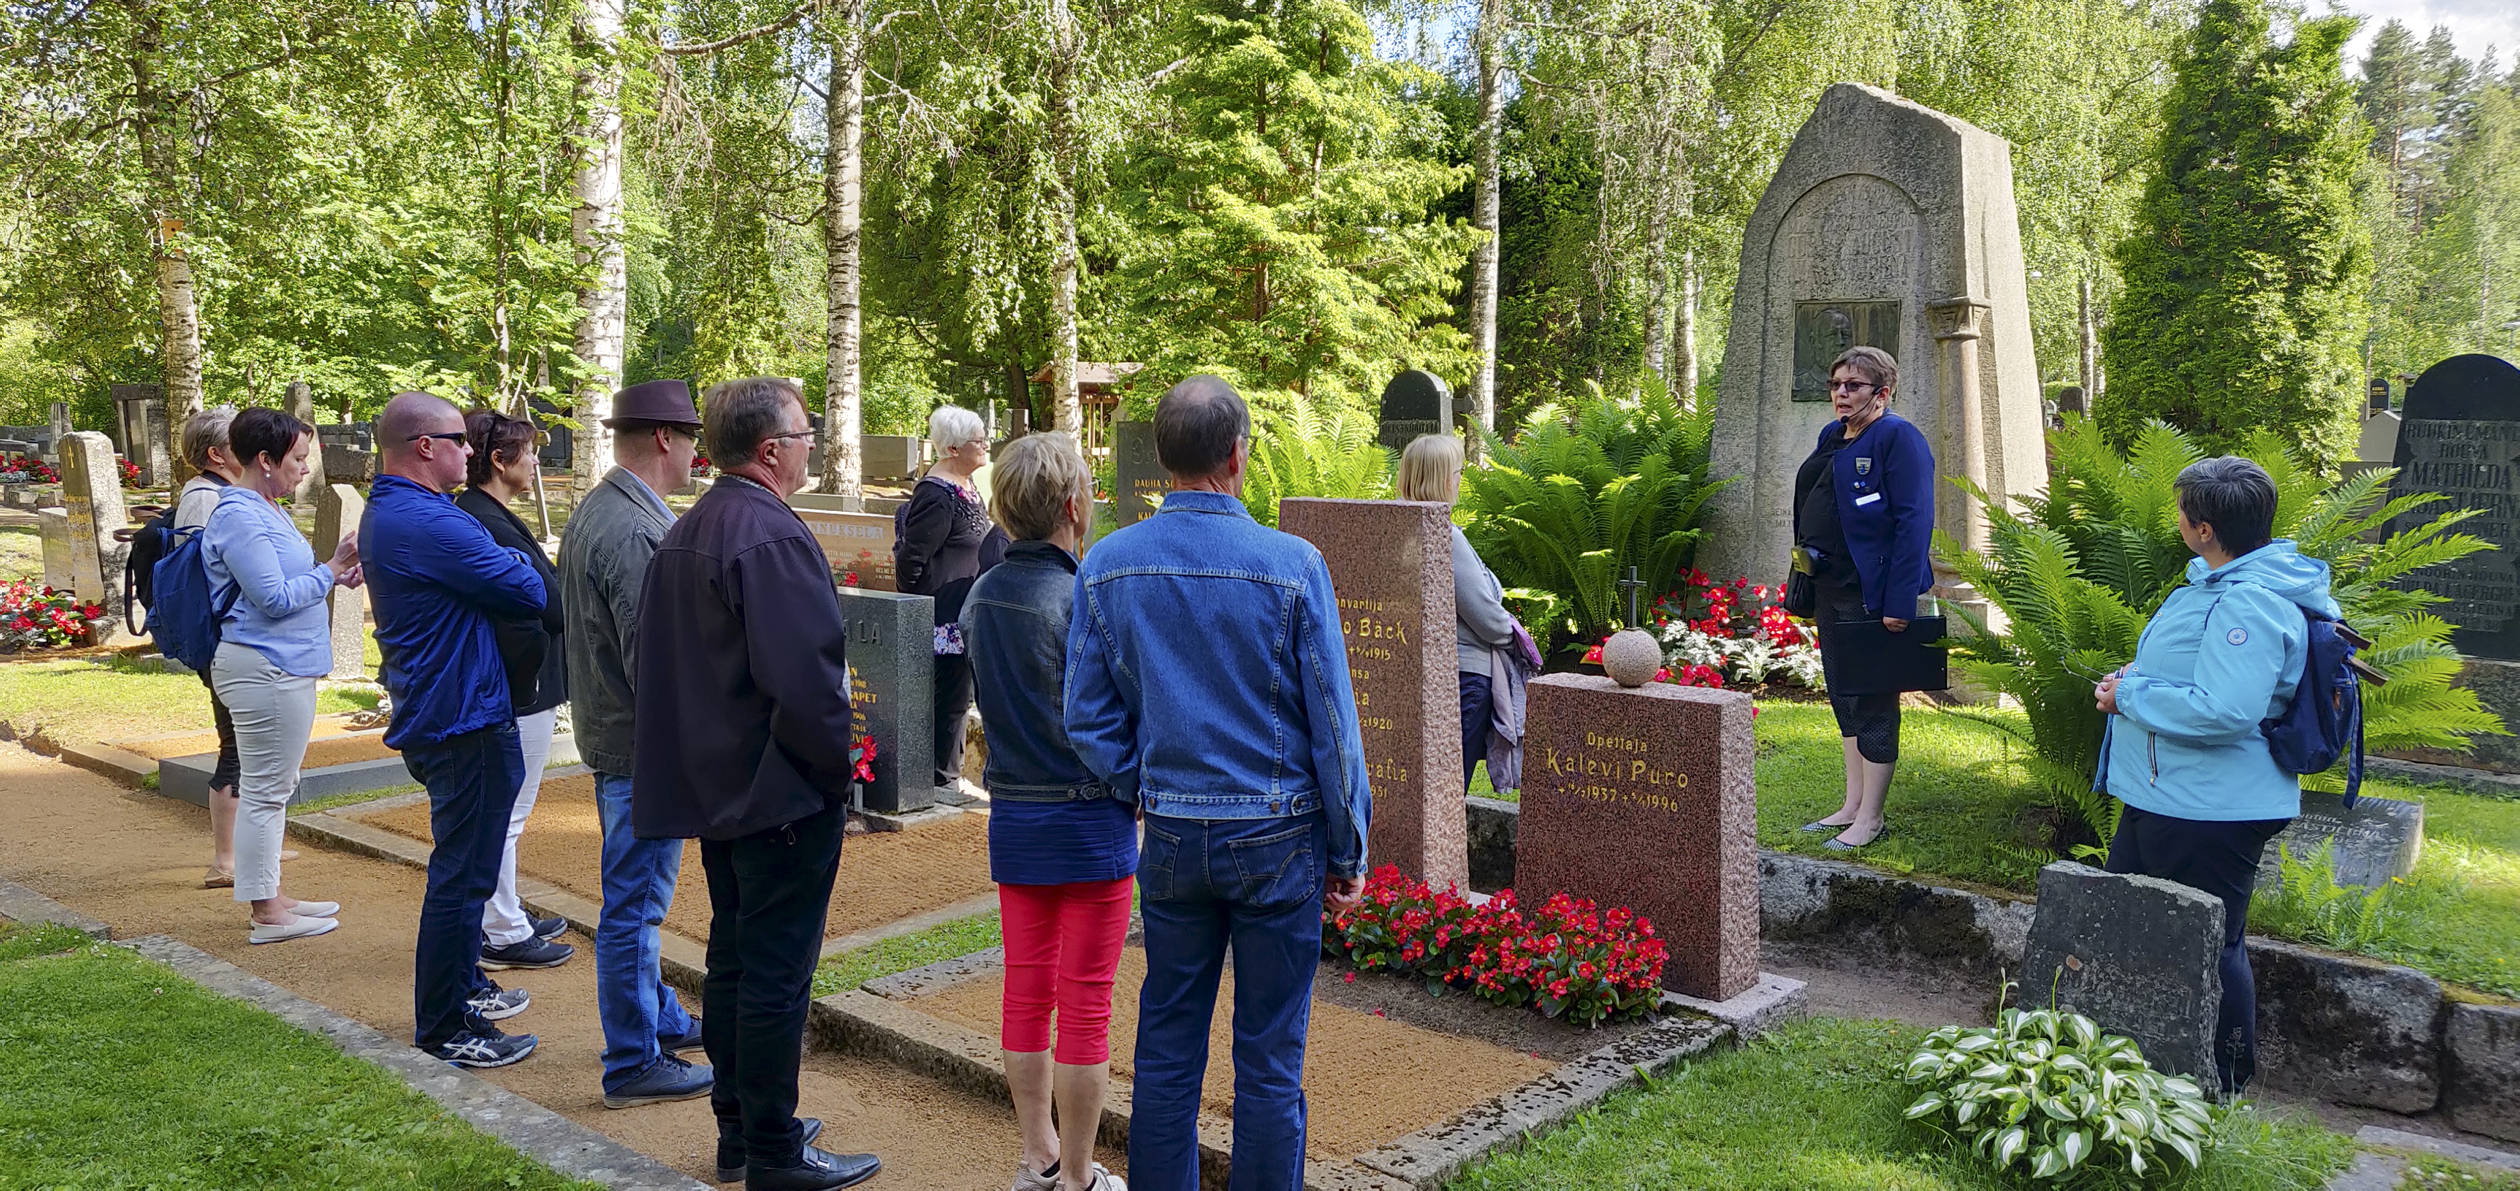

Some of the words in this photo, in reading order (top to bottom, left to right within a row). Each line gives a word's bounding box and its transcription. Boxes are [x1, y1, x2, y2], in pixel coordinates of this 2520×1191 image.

[1134, 479, 1161, 488] RAUHA
[2411, 461, 2511, 490] MATHILDA
[810, 522, 883, 540] NNUKSELA
[1359, 616, 1408, 646] Bäck
[850, 691, 878, 704] SAPET
[1586, 731, 1648, 753] Opettaja
[1366, 758, 1408, 782] rafia
[1547, 747, 1621, 781] Kalevi
[1630, 759, 1689, 788] Puro
[1371, 784, 1388, 799] 951
